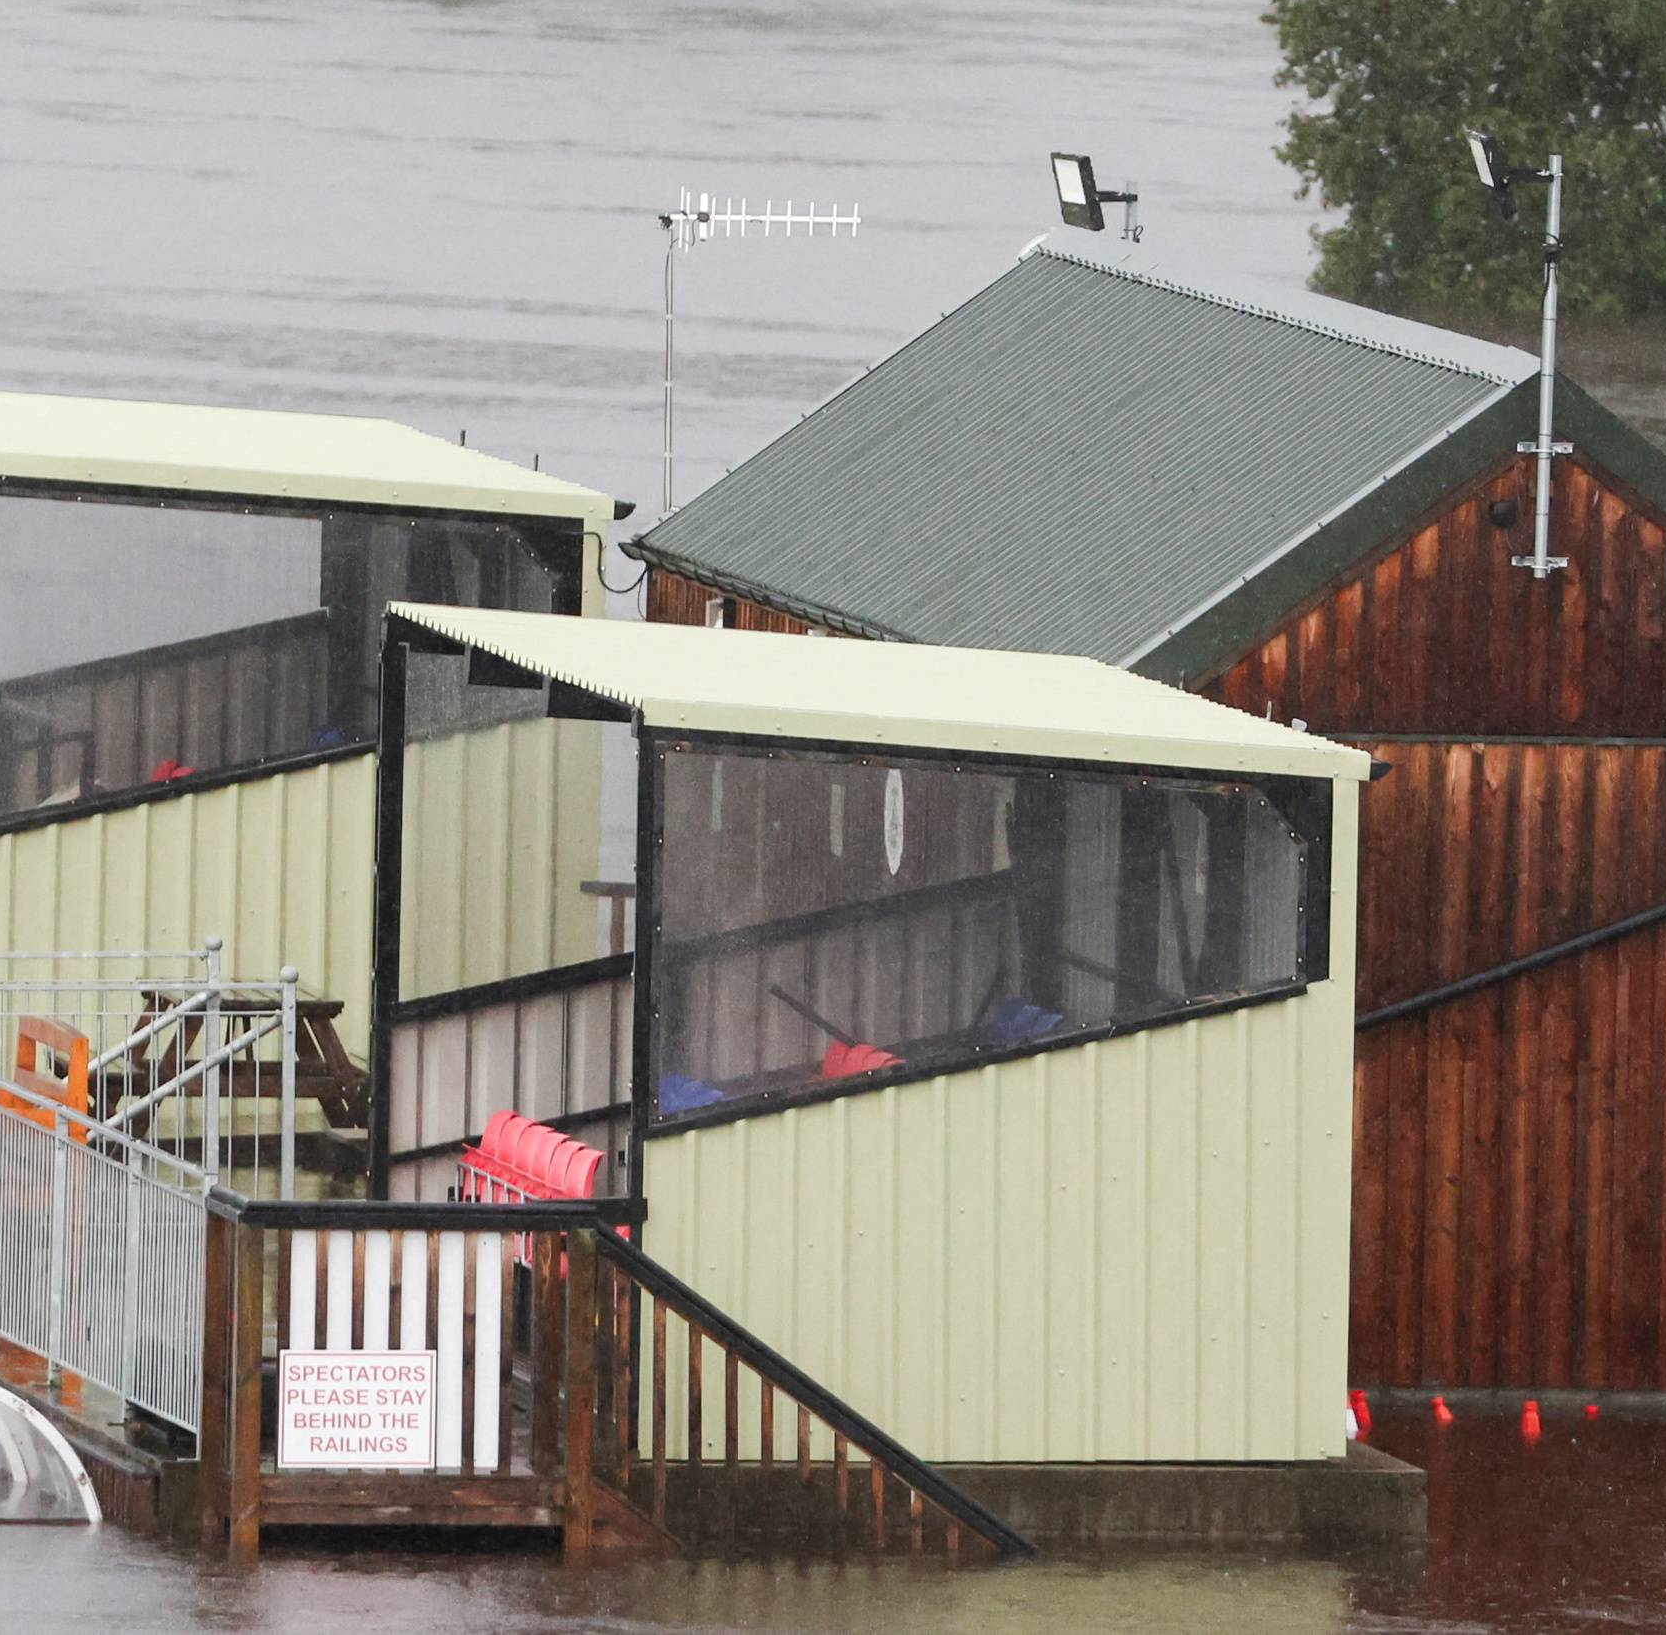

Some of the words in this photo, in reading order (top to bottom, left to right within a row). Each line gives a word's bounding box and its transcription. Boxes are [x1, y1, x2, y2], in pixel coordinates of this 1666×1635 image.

[288, 1365, 426, 1382] SPECTATORS
[287, 1389, 369, 1406] PLEASE
[376, 1389, 427, 1406] STAY
[294, 1412, 372, 1429] BEHIND
[379, 1412, 419, 1429] THE
[310, 1436, 408, 1453] RAILINGS
